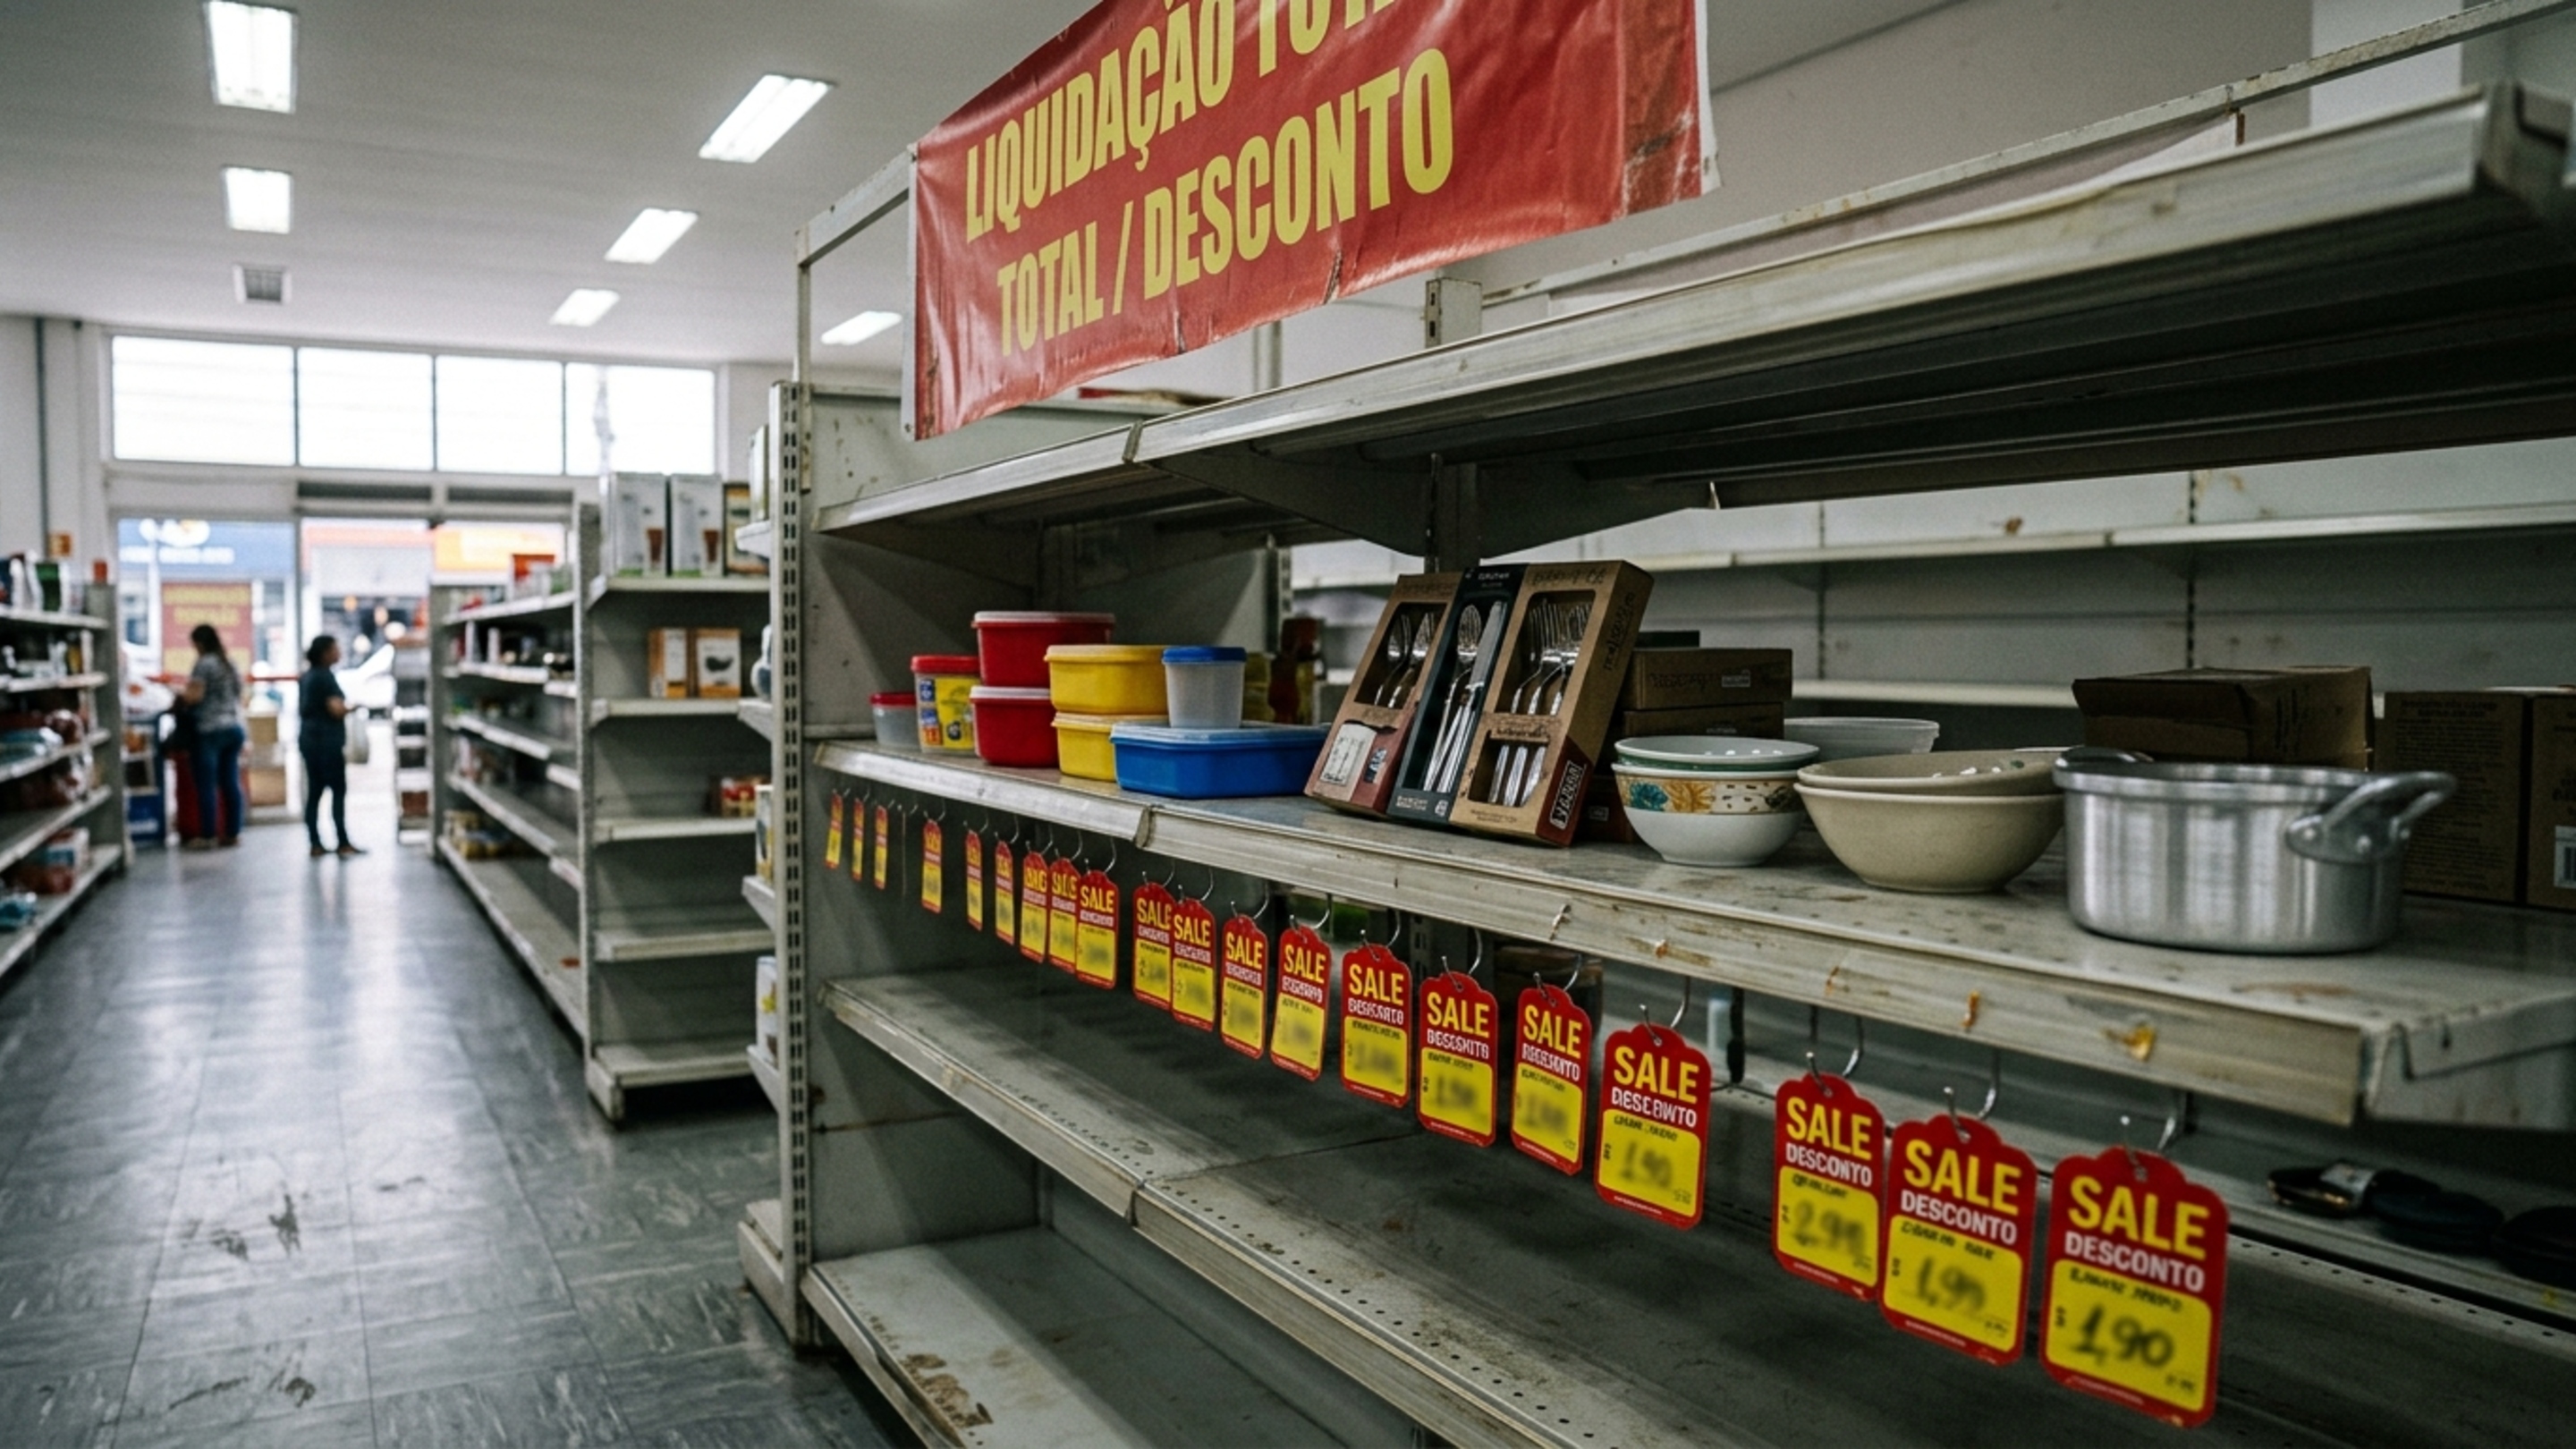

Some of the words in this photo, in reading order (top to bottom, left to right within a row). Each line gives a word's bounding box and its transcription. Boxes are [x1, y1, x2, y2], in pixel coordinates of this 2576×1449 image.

[966, 0, 1236, 243] LIQUIDAÇÃO
[996, 228, 1103, 358] TOTAL
[1144, 47, 1454, 301] DESCONTO
[1079, 885, 1115, 914] SALE
[1136, 897, 1173, 931] SALE
[1173, 913, 1212, 948] SALE
[1225, 931, 1264, 970] SALE
[1284, 944, 1326, 984] SALE
[1349, 962, 1404, 1006] SALE
[1427, 991, 1490, 1038] SALE
[1523, 1004, 1583, 1060] SALE
[1614, 1045, 1699, 1105] SALE
[1786, 1096, 1873, 1161] SALE
[1902, 1139, 2022, 1216] SALE
[1901, 1189, 2018, 1246] DESCONTO
[2068, 1174, 2209, 1261] SALE
[2063, 1230, 2206, 1293] DESCONTO
